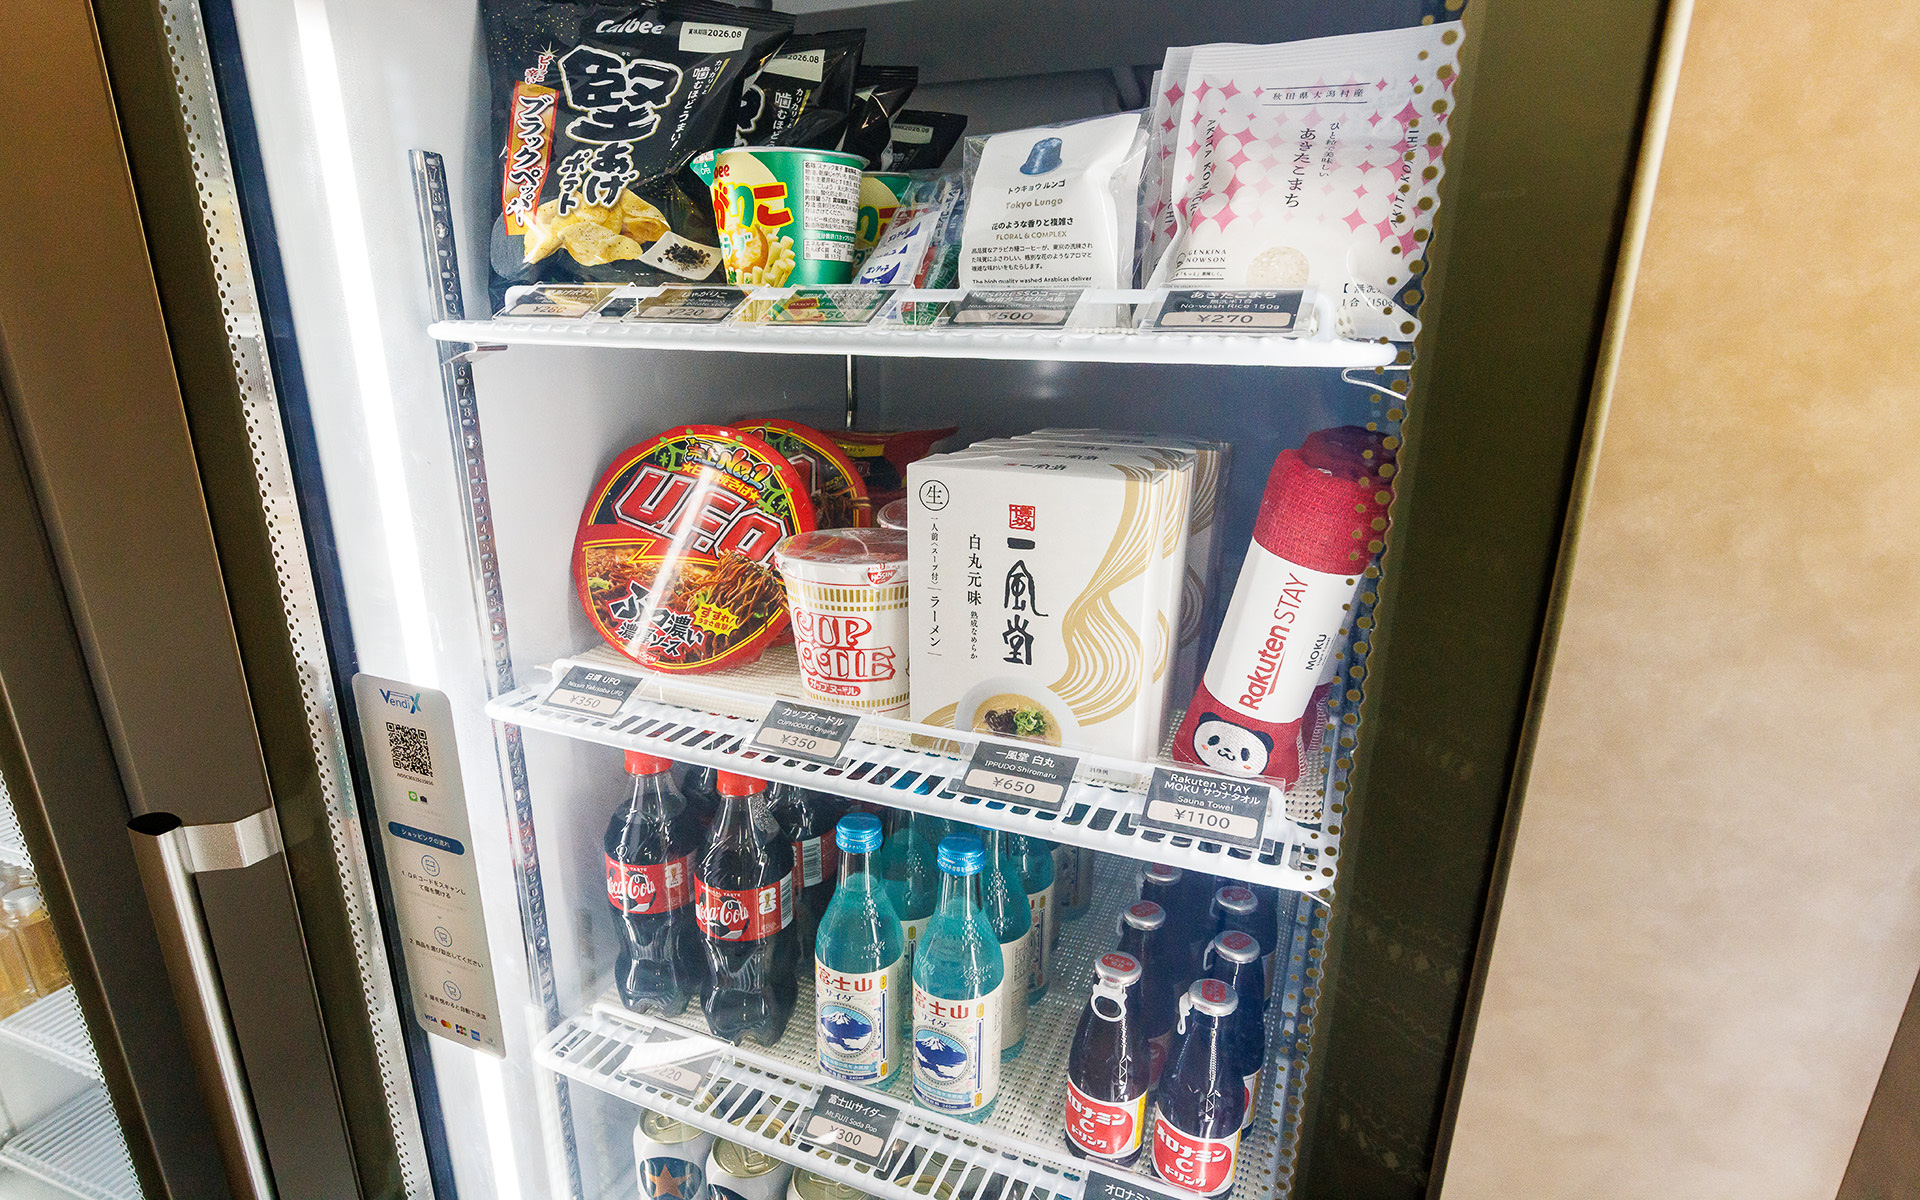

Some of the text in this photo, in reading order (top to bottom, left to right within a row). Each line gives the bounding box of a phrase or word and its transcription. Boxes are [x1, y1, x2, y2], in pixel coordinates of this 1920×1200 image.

[596, 18, 666, 35] Calbee
[1205, 119, 1217, 158] AKITA
[1285, 128, 1316, 208] あきたこまち
[557, 149, 593, 217] ポテト
[1005, 198, 1063, 210] Tokyo Lungo
[1031, 231, 1067, 239] COMPLEX
[1191, 291, 1277, 299] あきたこまち
[987, 312, 1034, 320] ¥500
[1198, 314, 1254, 323] ¥270
[925, 485, 943, 506] 生
[967, 533, 982, 606] 白丸元味
[1002, 537, 1048, 666] 一風堂
[793, 607, 872, 649] CUP
[1238, 572, 1309, 711] Rakuten STAY
[1305, 633, 1327, 671] MOKU
[602, 674, 621, 686] UFO
[809, 679, 860, 696] カップヌードル
[569, 694, 601, 709] ¥350
[611, 688, 624, 697] UFO
[782, 707, 845, 726] カップヌードル
[776, 718, 838, 735] CUPNOODLE Original
[780, 734, 817, 750] ¥350
[996, 750, 1055, 768] 一風堂 白丸
[985, 760, 1057, 780] IPPUDO Shiromaru
[993, 776, 1035, 794] ¥650
[1164, 781, 1261, 805] MOKU サウナタオル
[1171, 774, 1251, 795] Rakuten STAY
[1178, 795, 1234, 812] Sauna Towel
[1174, 808, 1230, 829] ¥1100
[819, 966, 872, 992] 富士山
[914, 988, 969, 1019] 富士山
[424, 1013, 438, 1023] VISA
[656, 1067, 682, 1081] 220
[827, 1093, 886, 1119] 富士山サイダー
[825, 1109, 877, 1133] Mt.FUJI Soda Pop
[1079, 1118, 1095, 1133] C
[1071, 1123, 1107, 1148] ドリンク
[1156, 1122, 1227, 1163] オロナミン
[1175, 1157, 1193, 1173] C
[1165, 1163, 1206, 1187] ドリンク
